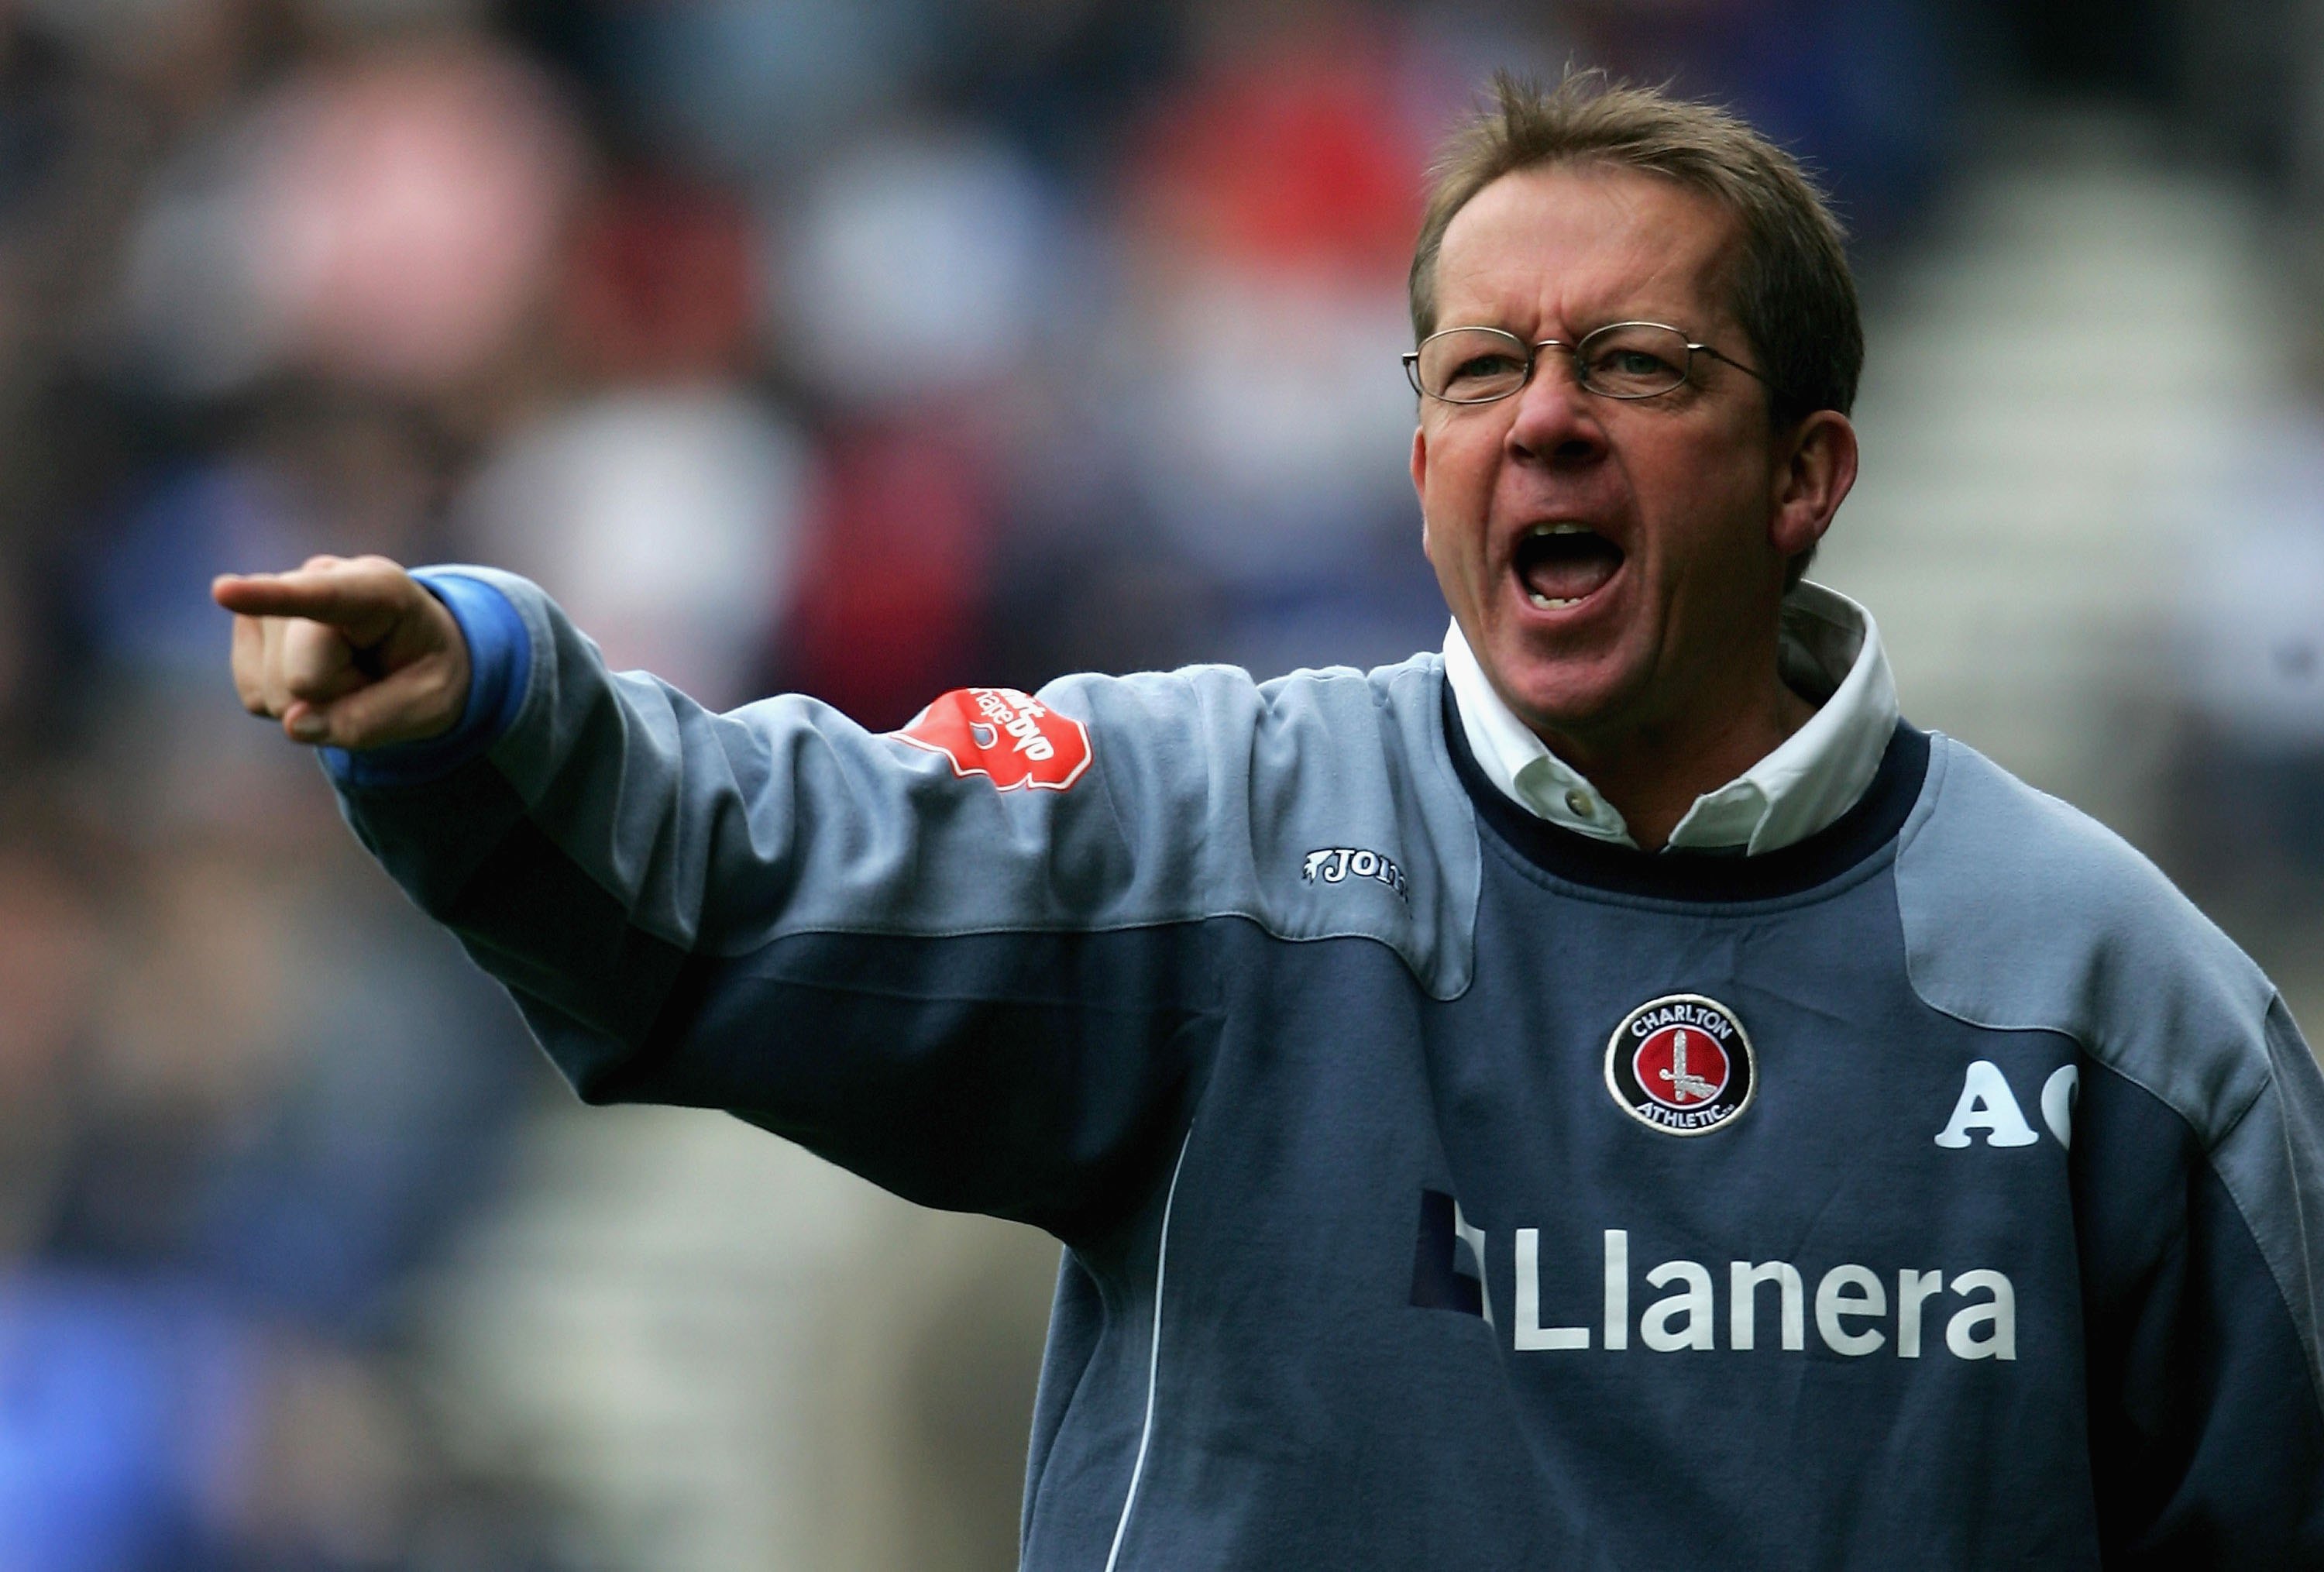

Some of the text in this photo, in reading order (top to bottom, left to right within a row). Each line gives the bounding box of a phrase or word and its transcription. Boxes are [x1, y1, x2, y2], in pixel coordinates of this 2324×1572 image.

[1005, 710, 1054, 760] DVD
[1631, 1005, 1733, 1040] CHARLTON
[1636, 1102, 1725, 1127] ATHLETIC
[1514, 1228, 2017, 1361] Llanera
